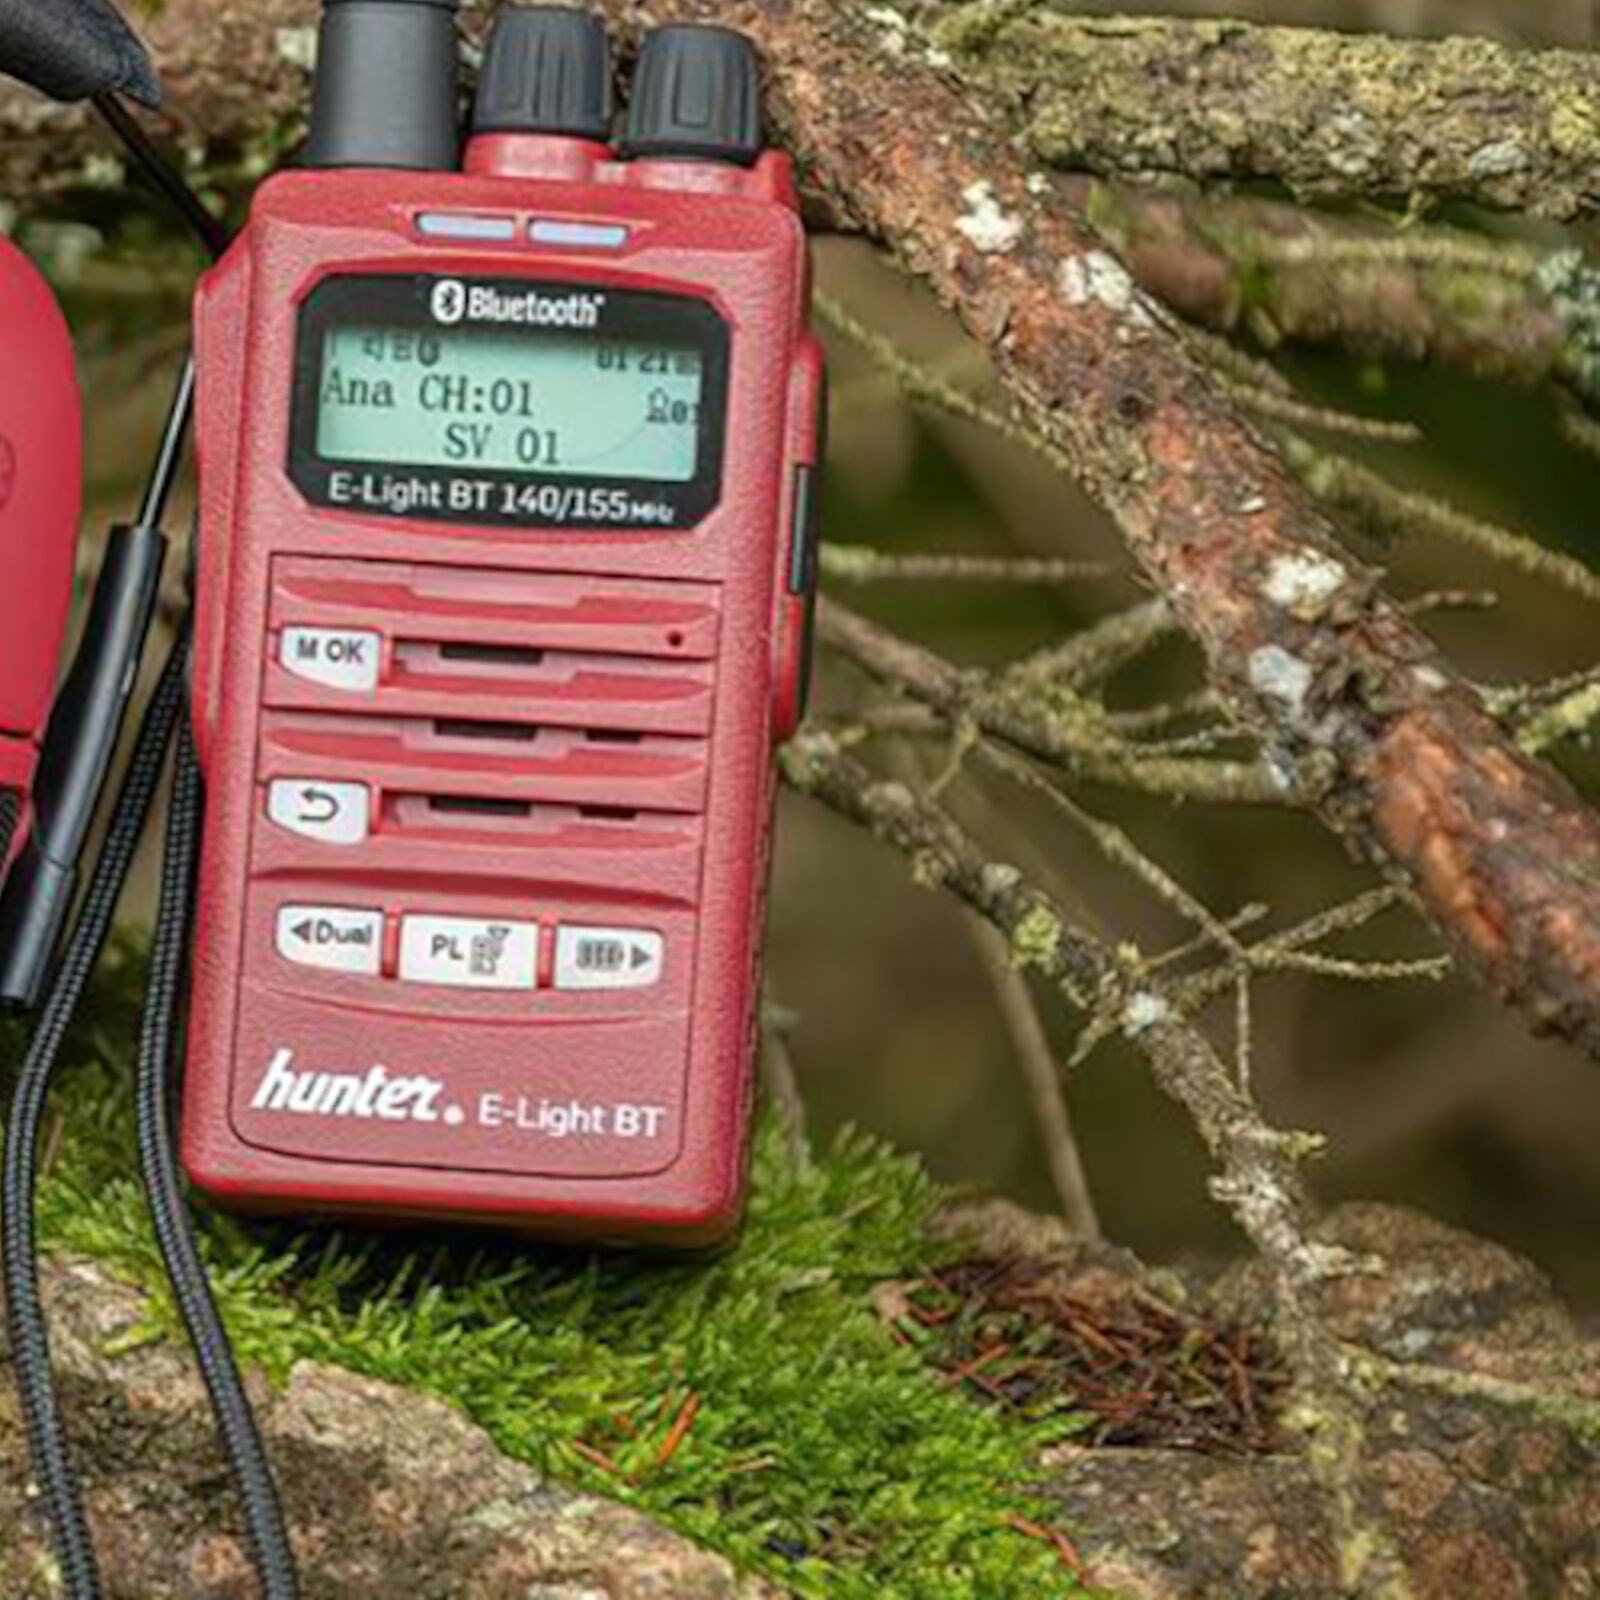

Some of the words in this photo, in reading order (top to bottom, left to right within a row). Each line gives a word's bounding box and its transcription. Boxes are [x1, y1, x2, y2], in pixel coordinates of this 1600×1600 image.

[466, 286, 598, 327] Bluetooth
[322, 368, 395, 408] Ana
[443, 422, 493, 460] SV
[517, 428, 561, 464] 01
[329, 472, 441, 513] E-Light
[450, 480, 495, 511] BT
[326, 637, 366, 664] OK
[315, 919, 373, 946] Dual
[431, 934, 463, 961] PL
[478, 1094, 605, 1138] E-Light
[614, 1103, 666, 1139] BT
